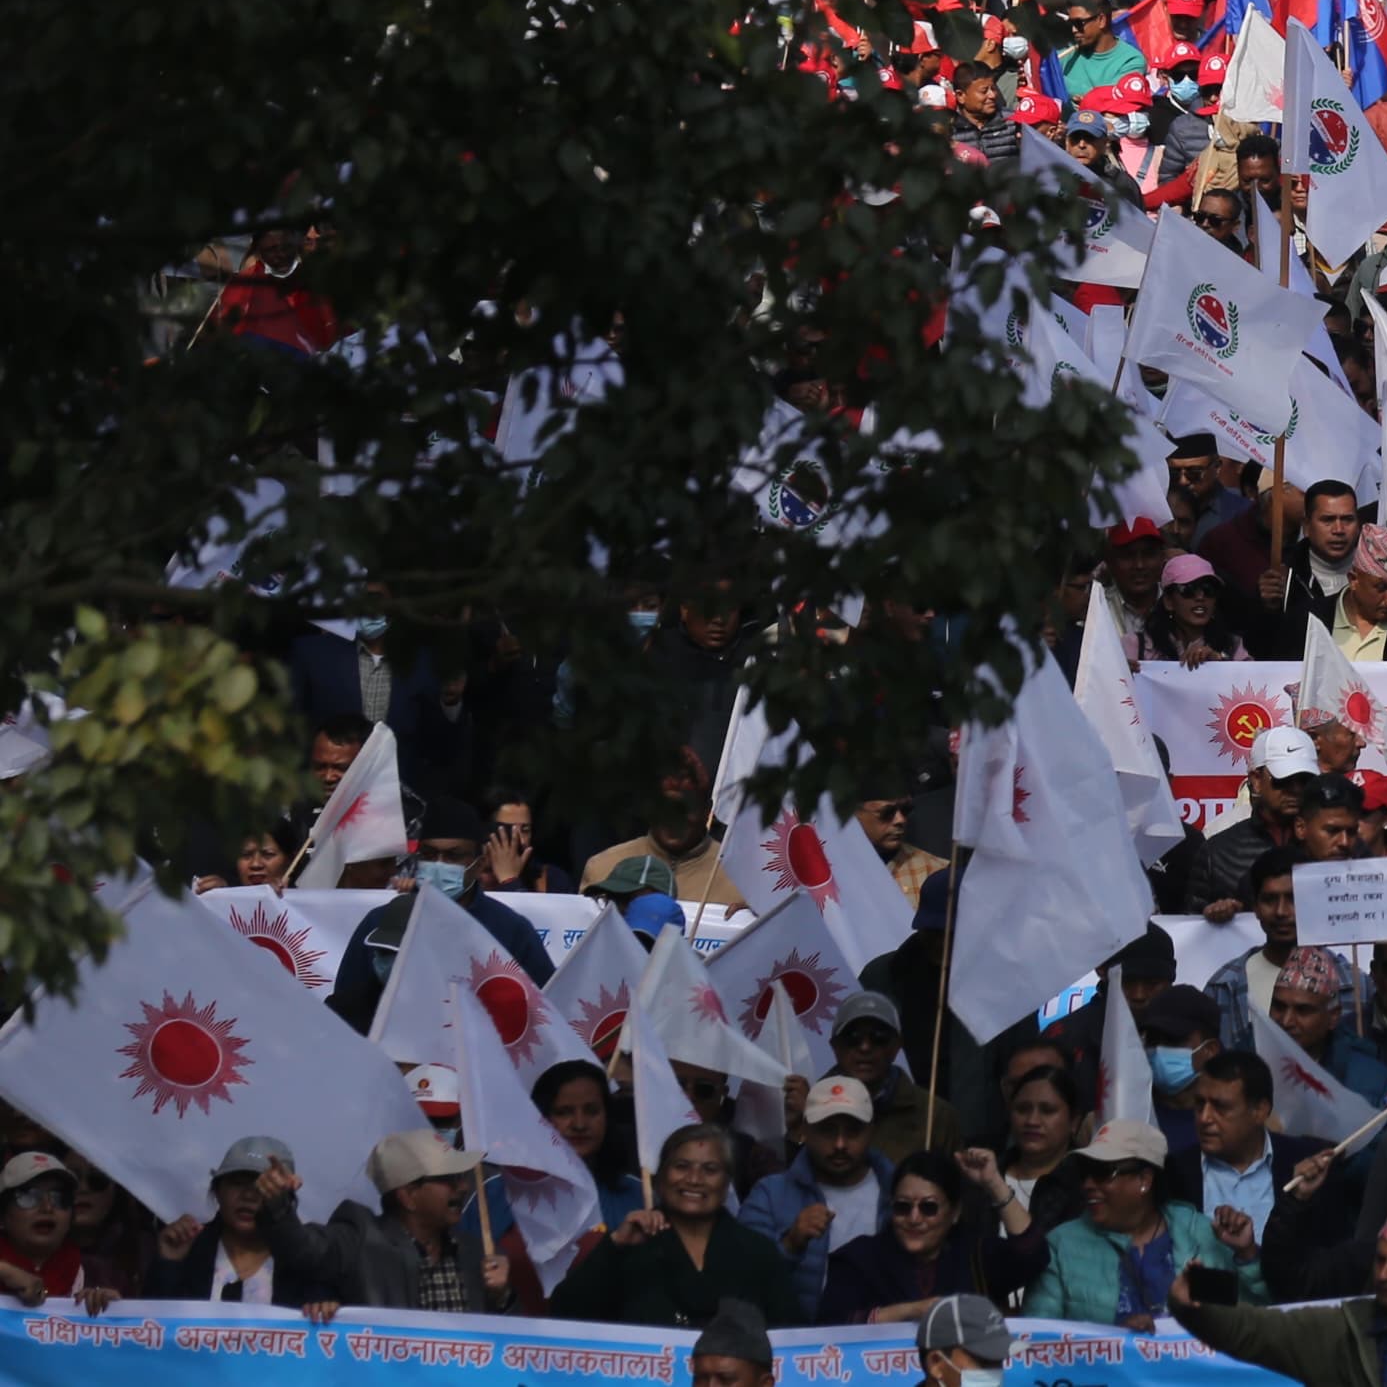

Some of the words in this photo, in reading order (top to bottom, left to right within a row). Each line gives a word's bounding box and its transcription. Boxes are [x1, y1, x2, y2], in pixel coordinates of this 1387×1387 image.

[25, 1318, 162, 1349] दक्षिणपन्थी
[176, 1327, 305, 1356] अवसरवाद
[317, 1330, 337, 1357] र
[348, 1328, 493, 1366] संगठनात्मक
[504, 1343, 674, 1382] अराजकतालाई
